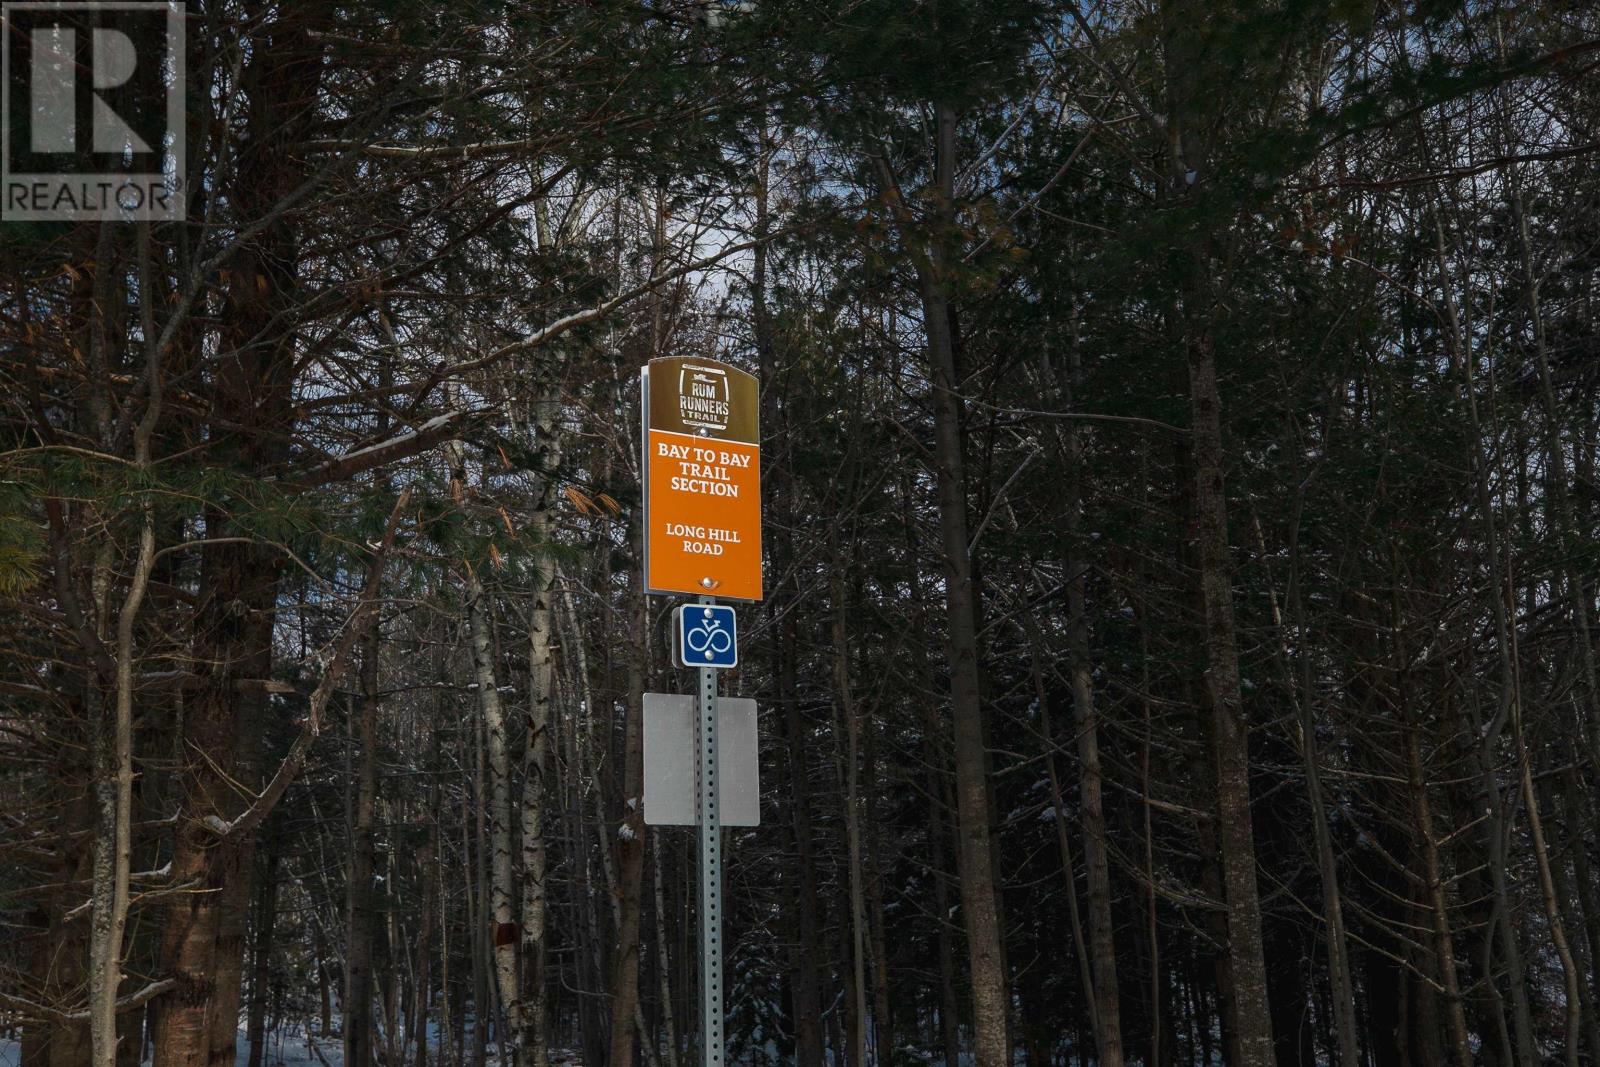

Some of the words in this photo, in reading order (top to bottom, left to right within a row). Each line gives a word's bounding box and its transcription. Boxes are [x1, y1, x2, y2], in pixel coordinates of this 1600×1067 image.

[692, 382, 715, 399] RUM
[680, 395, 729, 416] RUNNERS
[687, 410, 720, 423] TRAIL
[658, 442, 690, 460] BAY
[694, 448, 716, 463] TO
[719, 452, 750, 468] BAY
[679, 462, 730, 481] TRAIL
[671, 476, 738, 498] SECTION
[666, 523, 705, 539] LONG
[708, 528, 741, 543] HILL
[683, 541, 723, 556] ROAD
